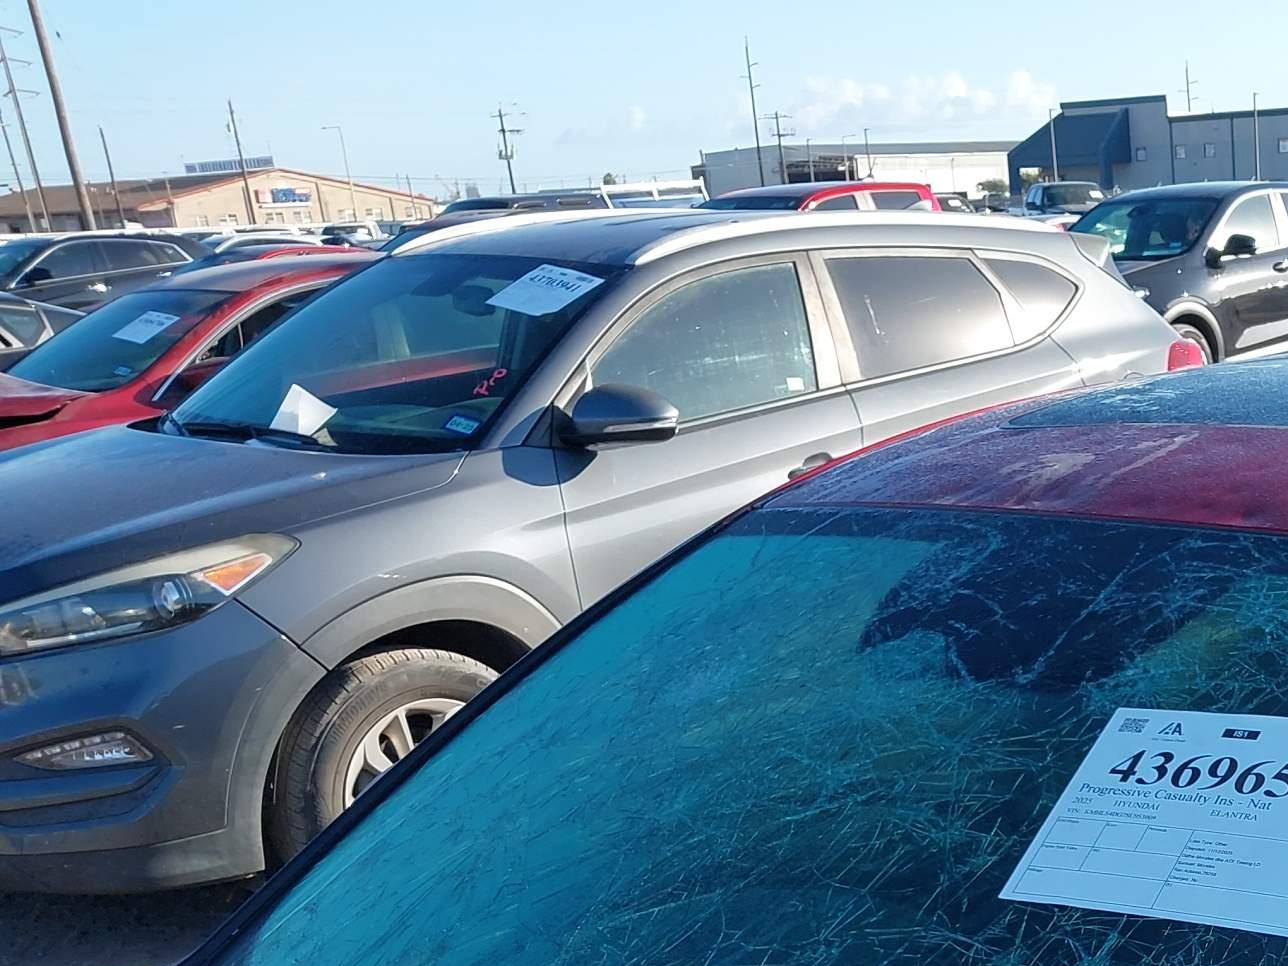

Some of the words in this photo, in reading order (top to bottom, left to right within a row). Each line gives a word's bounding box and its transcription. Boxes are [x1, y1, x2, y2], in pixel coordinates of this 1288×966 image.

[1079, 783, 1152, 799] Progressive
[1154, 788, 1210, 805] Casualty
[1214, 797, 1234, 807] Ins
[1247, 798, 1273, 811] Nat
[1112, 799, 1160, 811] HYUNDAI
[1209, 809, 1258, 821] ELANTRA
